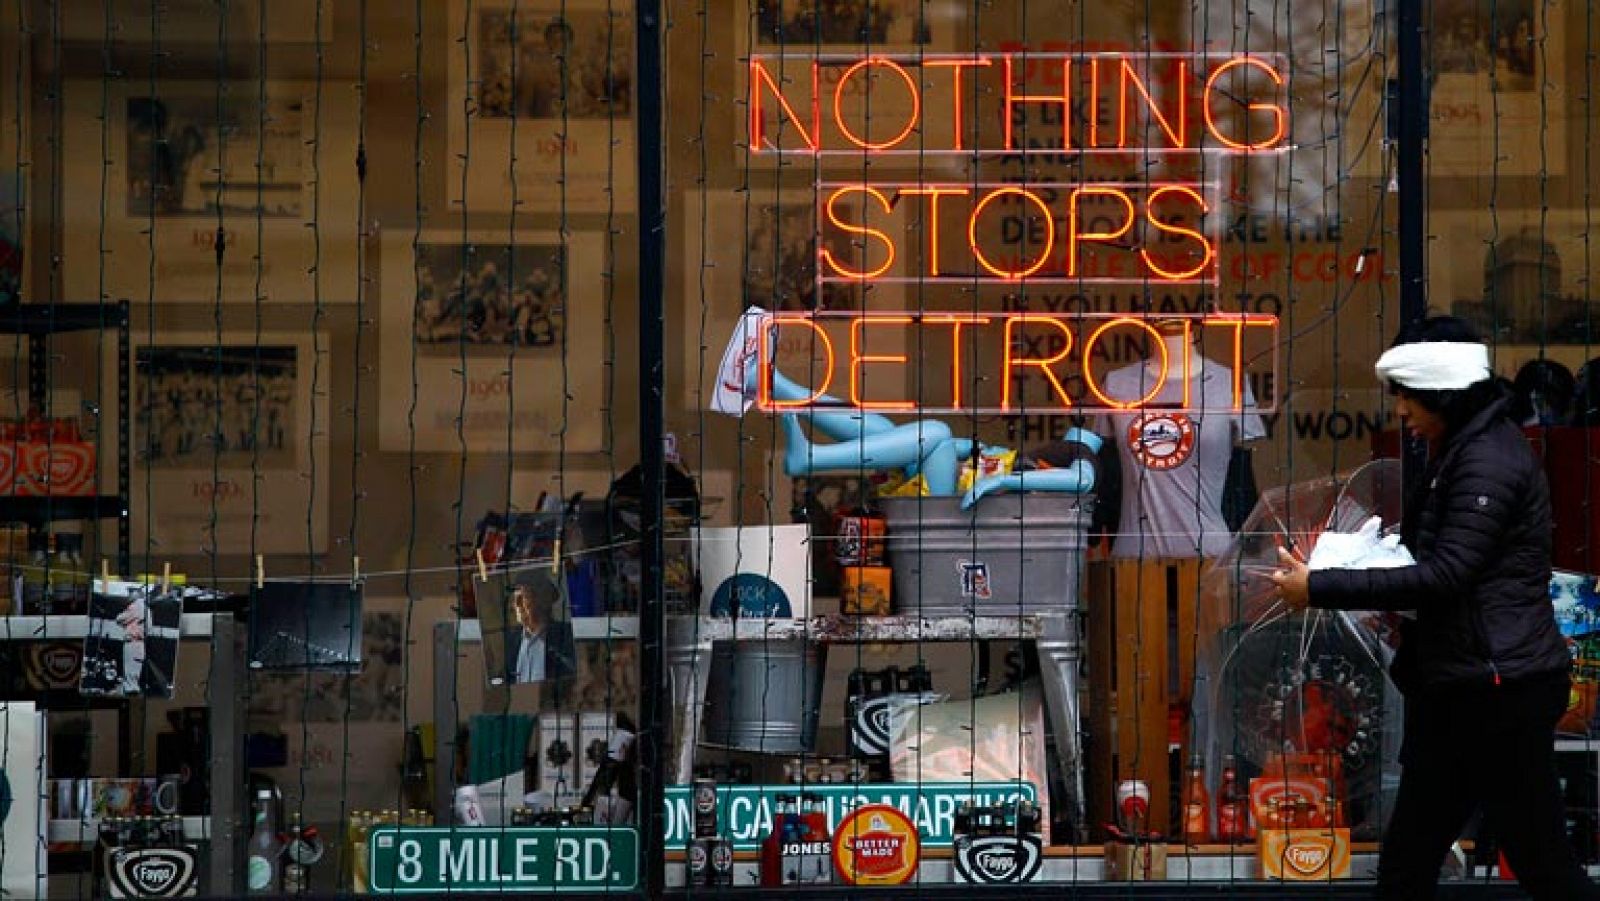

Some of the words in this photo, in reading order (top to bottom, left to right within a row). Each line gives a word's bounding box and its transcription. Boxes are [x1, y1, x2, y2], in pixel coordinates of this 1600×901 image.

[751, 57, 1288, 151] NOTHING
[1041, 98, 1110, 125] LKE
[820, 186, 1213, 278] STOPS
[1002, 215, 1146, 244] DETOT
[1281, 214, 1341, 243] THE
[1231, 252, 1282, 282] OF
[1294, 252, 1392, 283] COOL
[1235, 293, 1282, 322] TO
[1006, 333, 1151, 362] EXPAIN
[760, 317, 1277, 408] DETROIT
[1295, 411, 1393, 440] WON'
[782, 842, 832, 856] JONES
[855, 838, 899, 849] BETTER
[861, 848, 894, 857] MADE
[398, 839, 423, 883] 8
[439, 837, 539, 883] MILE
[555, 837, 621, 882] RD.
[982, 854, 1014, 873] Faygo
